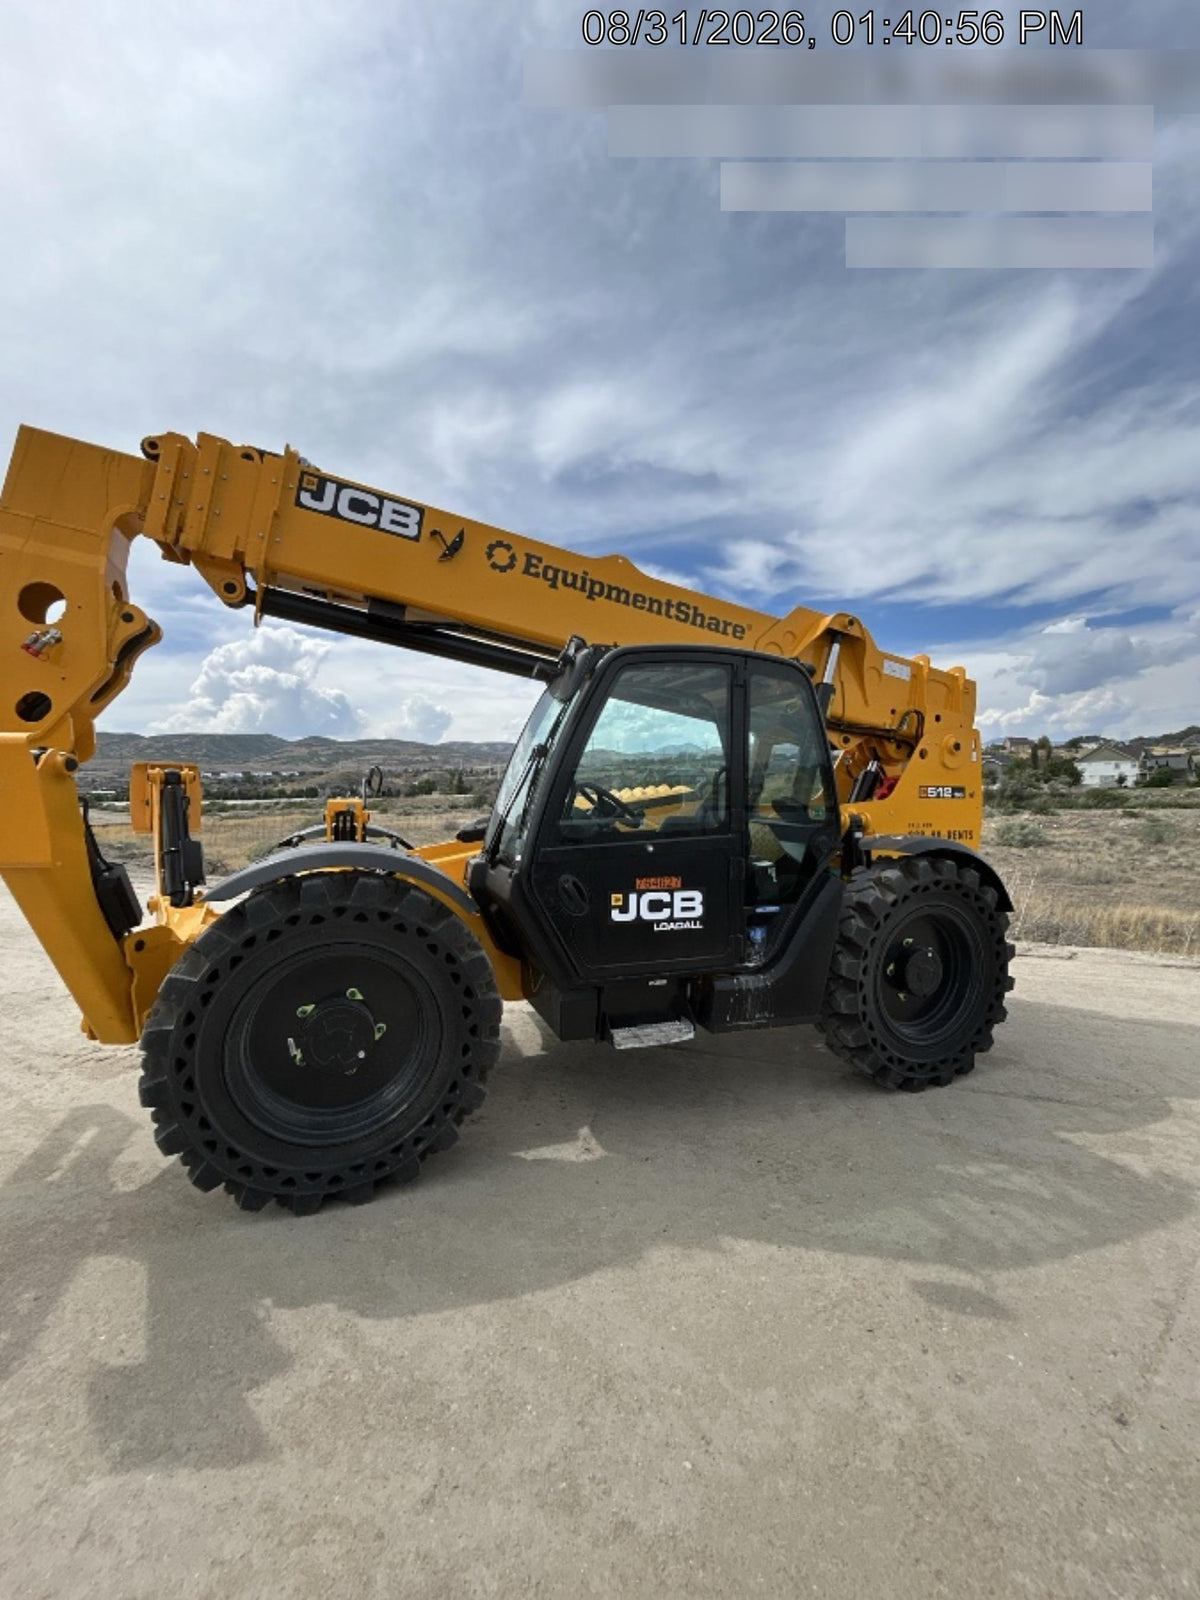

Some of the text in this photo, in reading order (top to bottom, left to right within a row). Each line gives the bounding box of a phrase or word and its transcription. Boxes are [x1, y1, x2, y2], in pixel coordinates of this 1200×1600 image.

[299, 478, 421, 538] JCB
[522, 552, 746, 641] EquipmentShare
[611, 890, 703, 922] JCB
